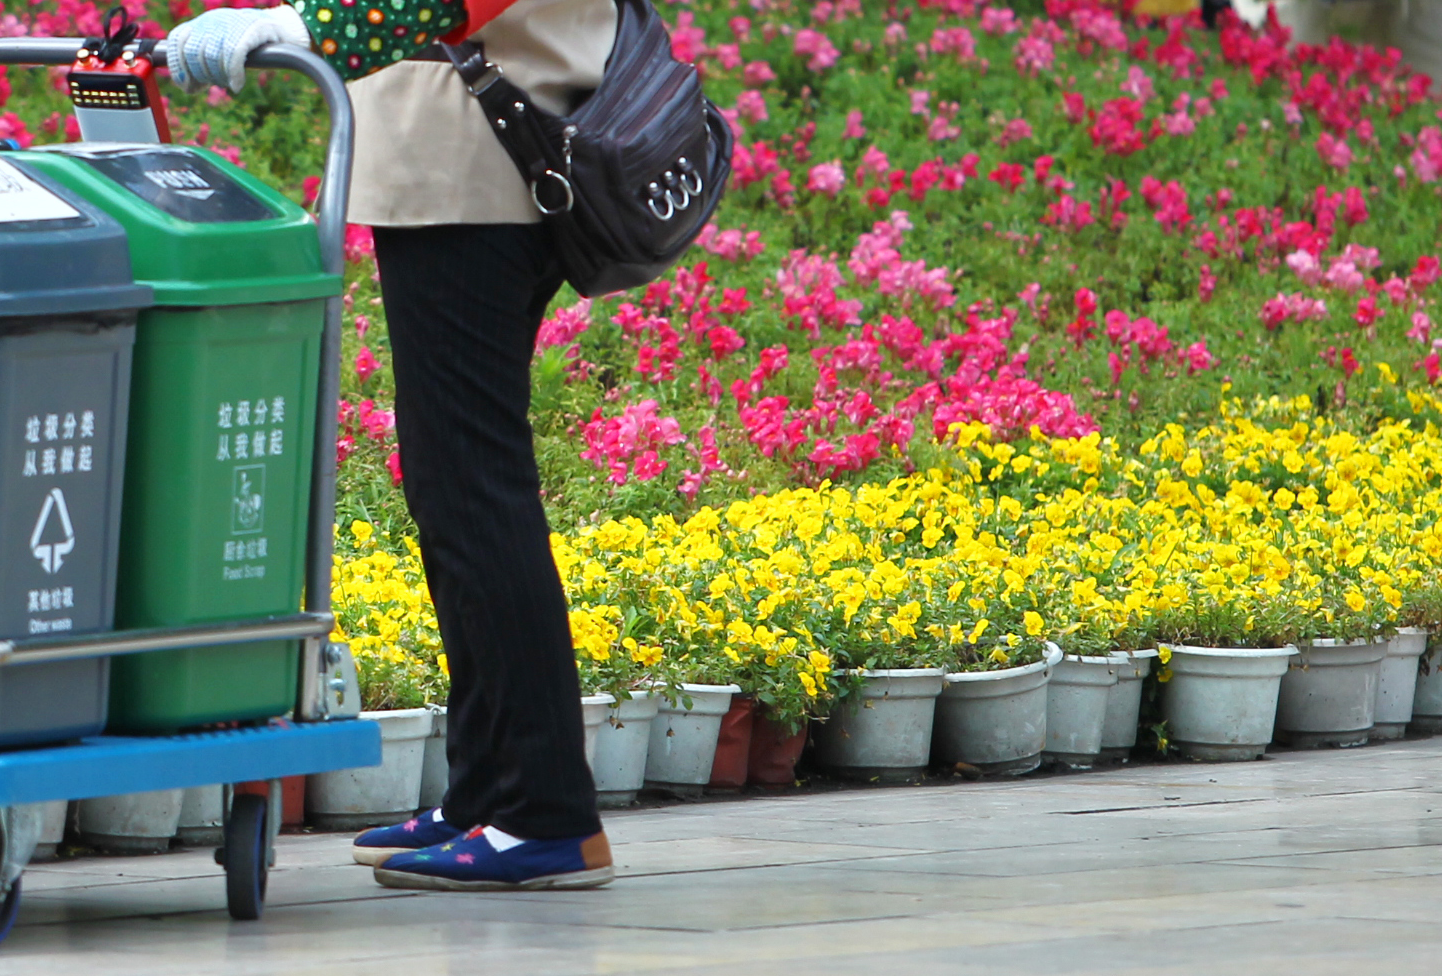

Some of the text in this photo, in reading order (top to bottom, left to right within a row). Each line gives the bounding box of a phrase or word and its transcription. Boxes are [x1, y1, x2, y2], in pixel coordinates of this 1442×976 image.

[24, 410, 95, 444] 垃圾分类
[218, 395, 285, 429] 垃圾分类
[216, 428, 284, 461] 从我做起
[22, 445, 93, 477] 从我做起
[27, 586, 74, 613] 其他垃圾
[29, 618, 50, 635] Other
